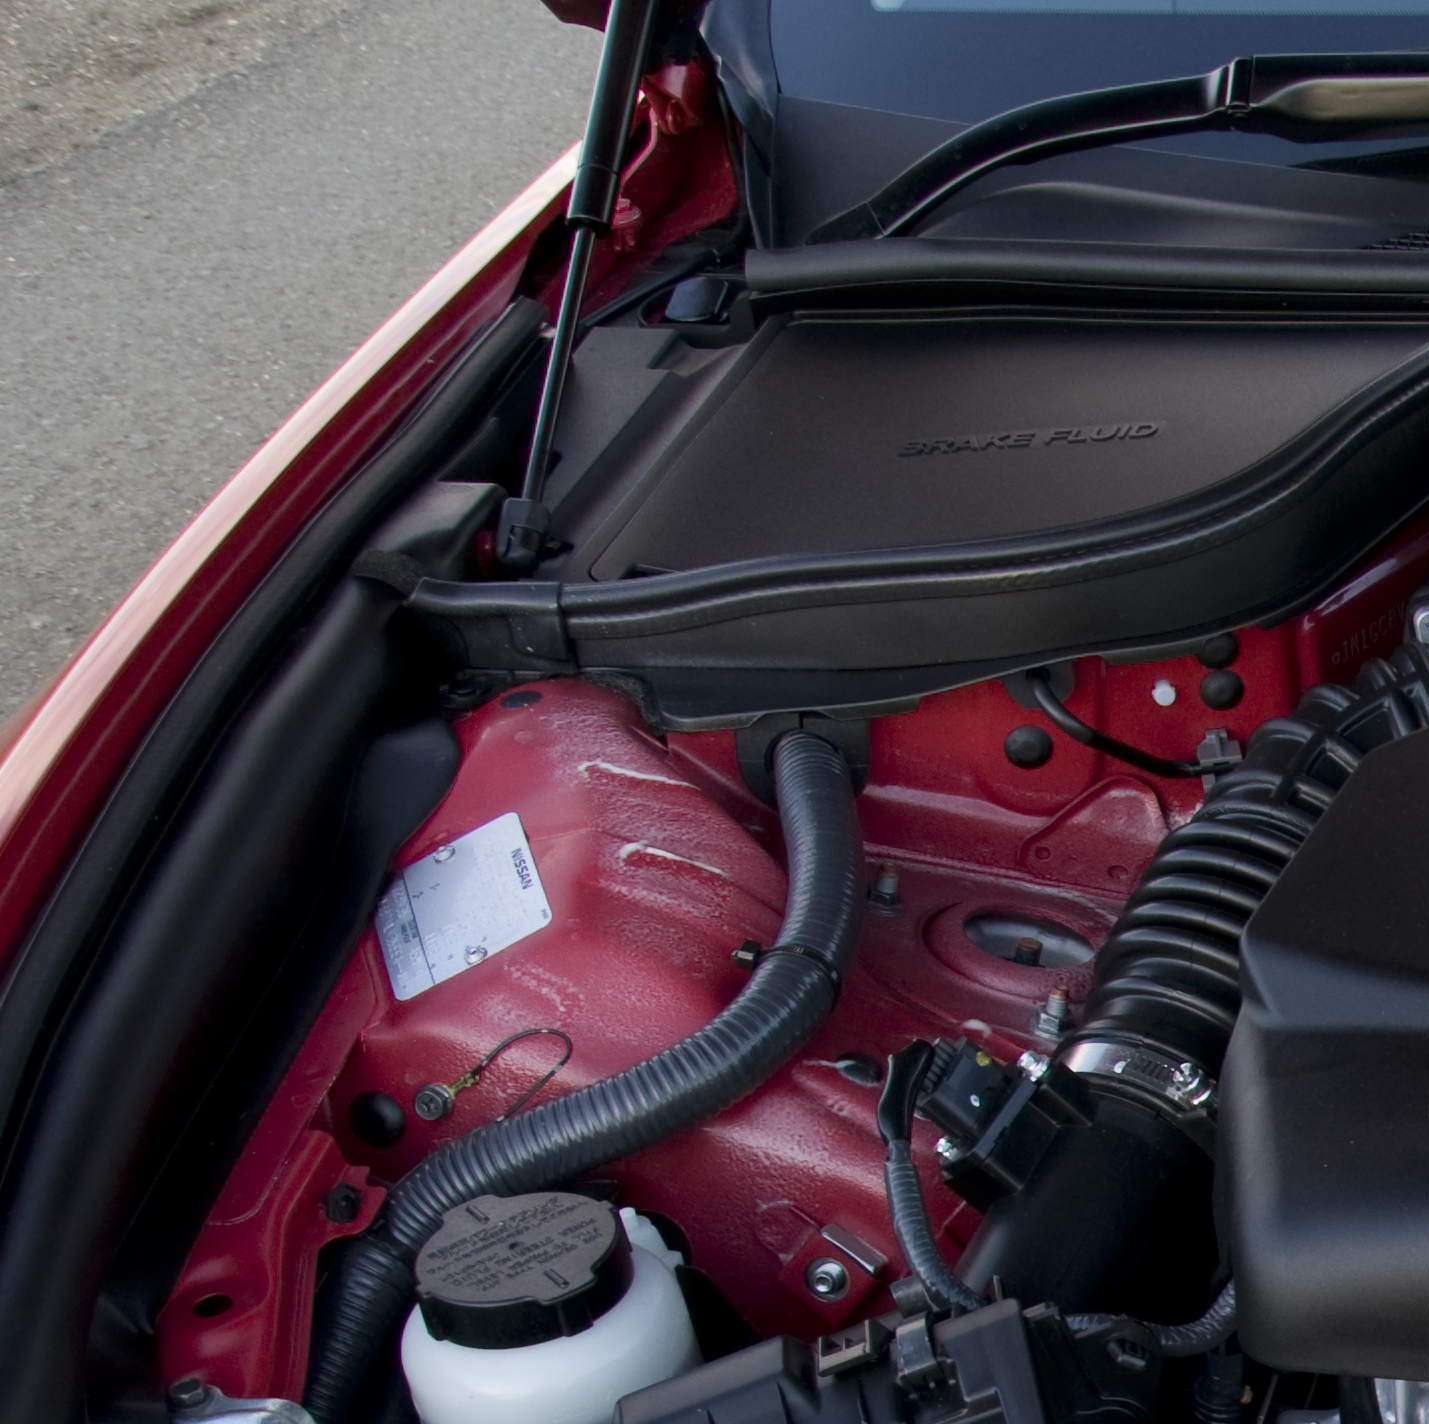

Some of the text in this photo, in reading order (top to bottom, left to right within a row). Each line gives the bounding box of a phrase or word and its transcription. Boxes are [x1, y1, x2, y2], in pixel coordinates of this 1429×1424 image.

[896, 423, 1160, 457] BRAKE FLUID
[510, 848, 533, 890] NISSAN
